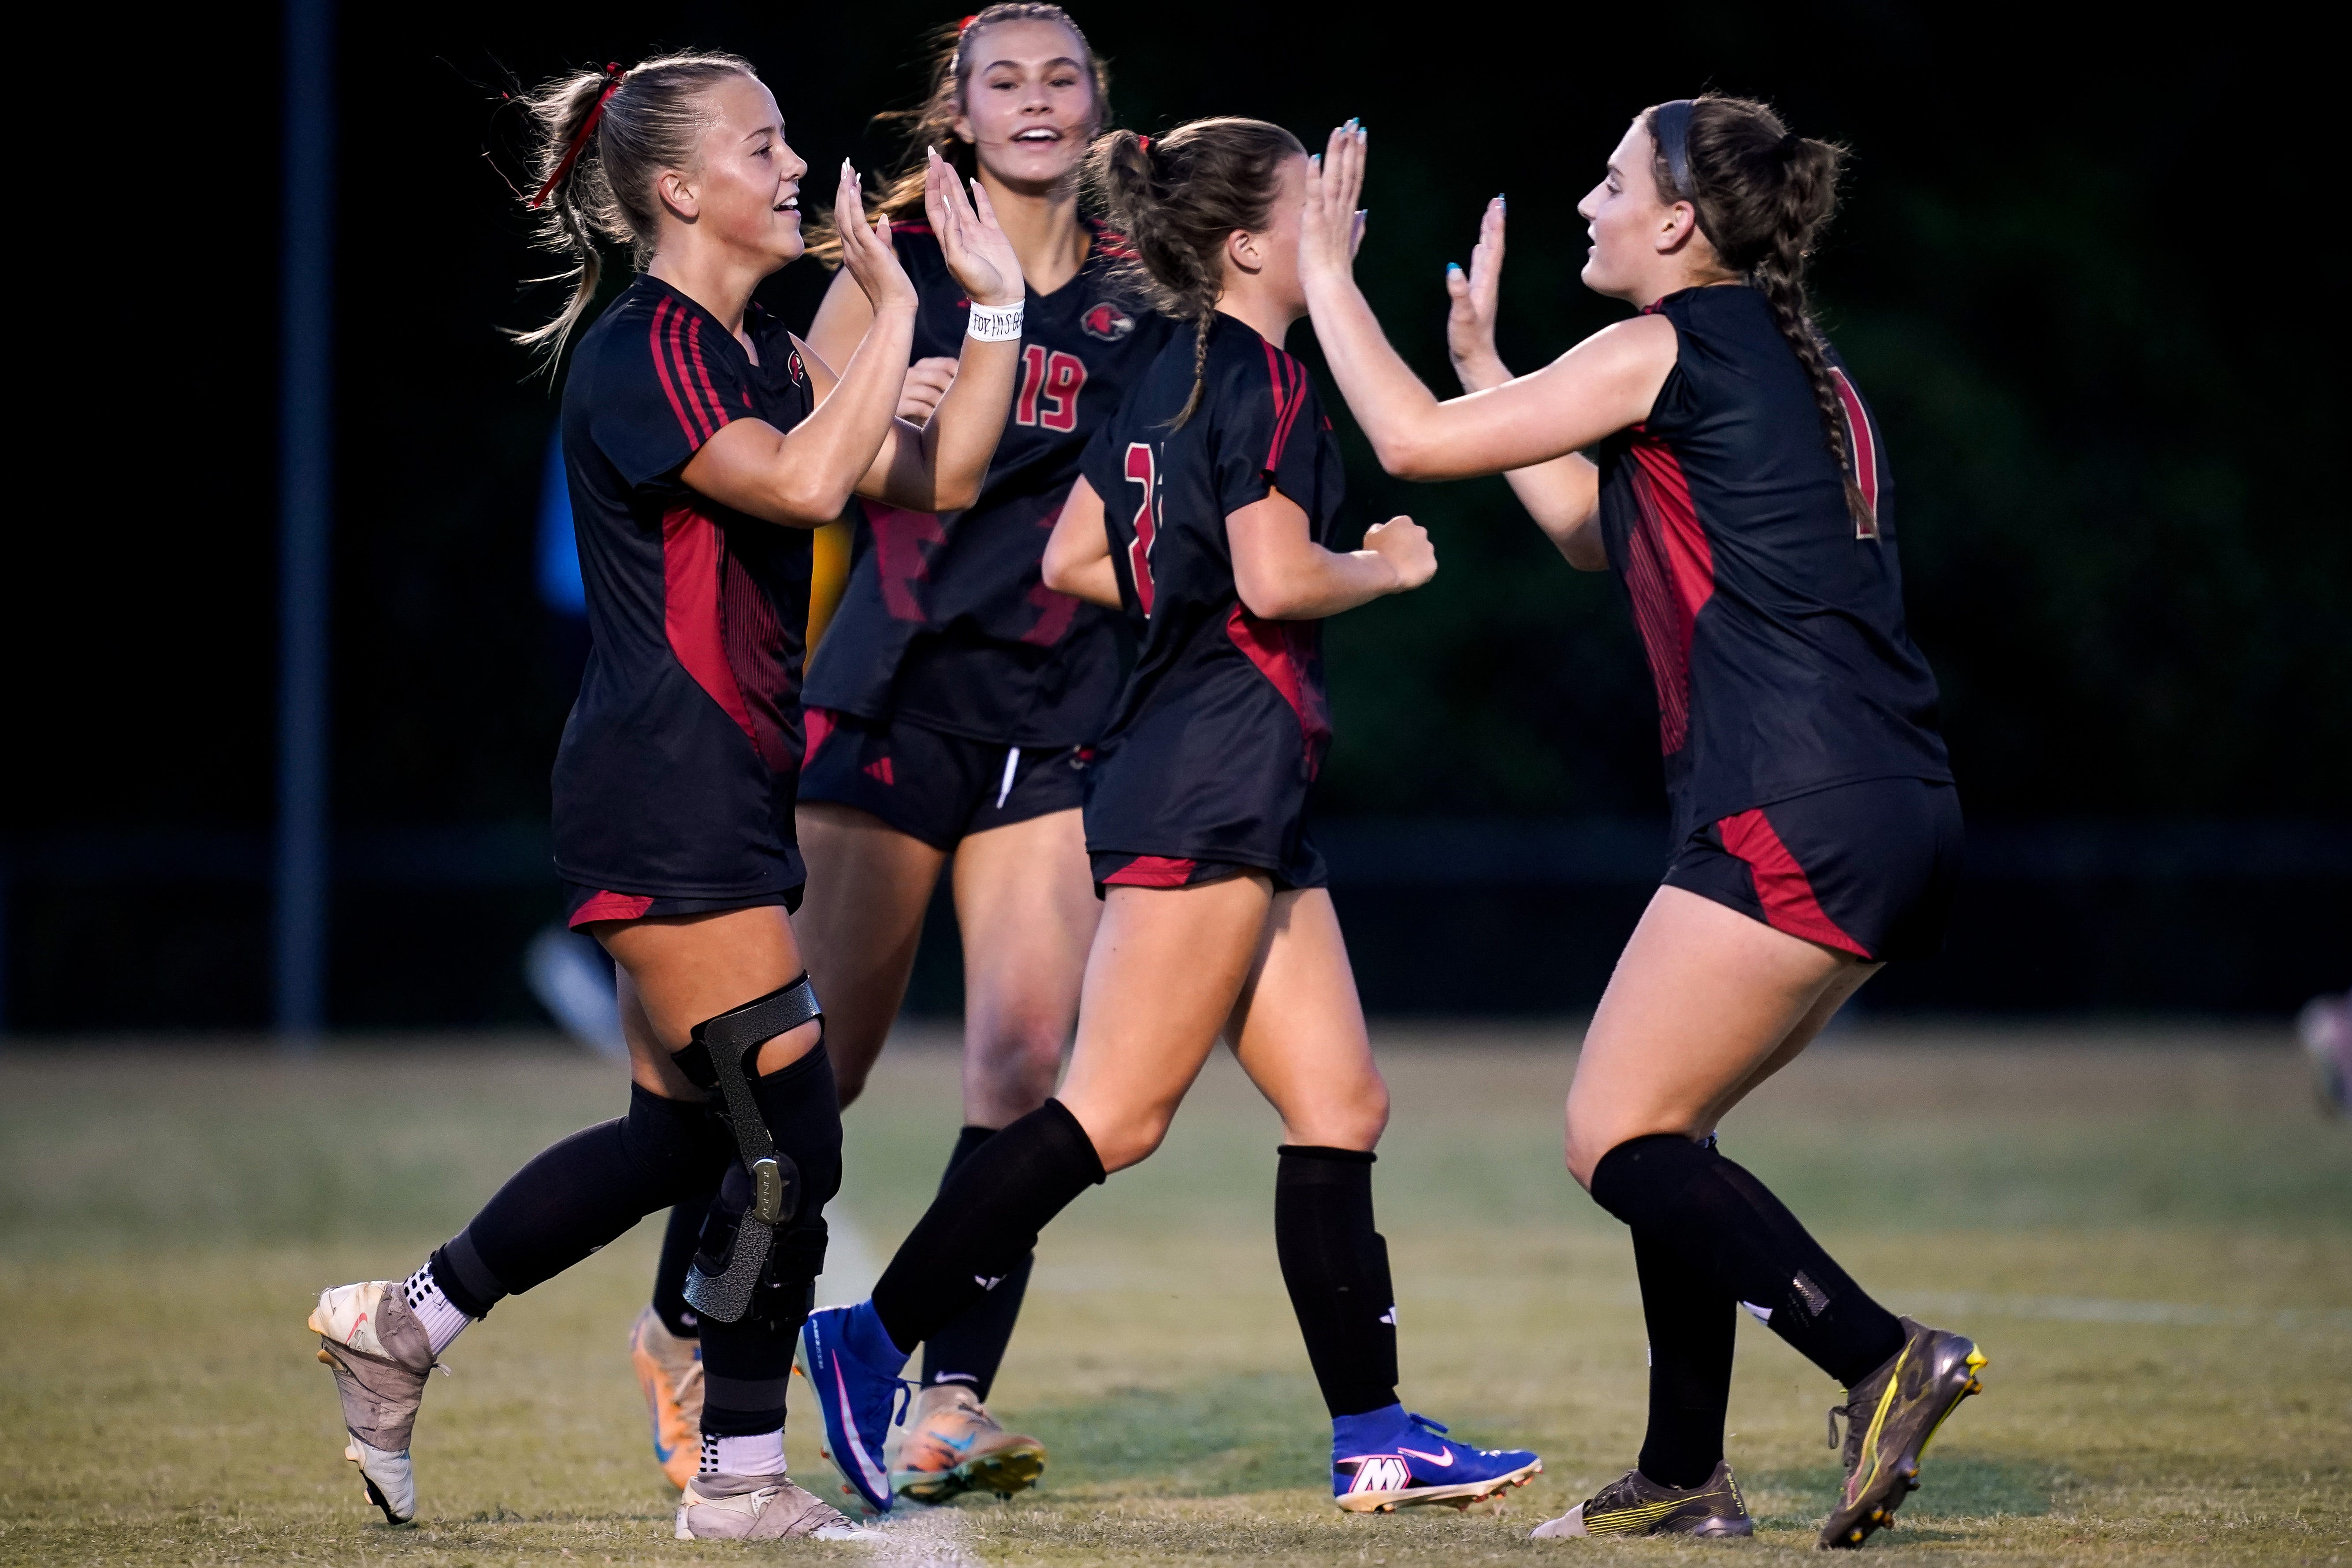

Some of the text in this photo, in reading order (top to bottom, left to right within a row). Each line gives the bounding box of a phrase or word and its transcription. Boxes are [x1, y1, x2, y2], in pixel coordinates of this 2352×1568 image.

[974, 313, 991, 335] FOR
[992, 314, 1011, 337] HIS
[1016, 344, 1088, 433] 19
